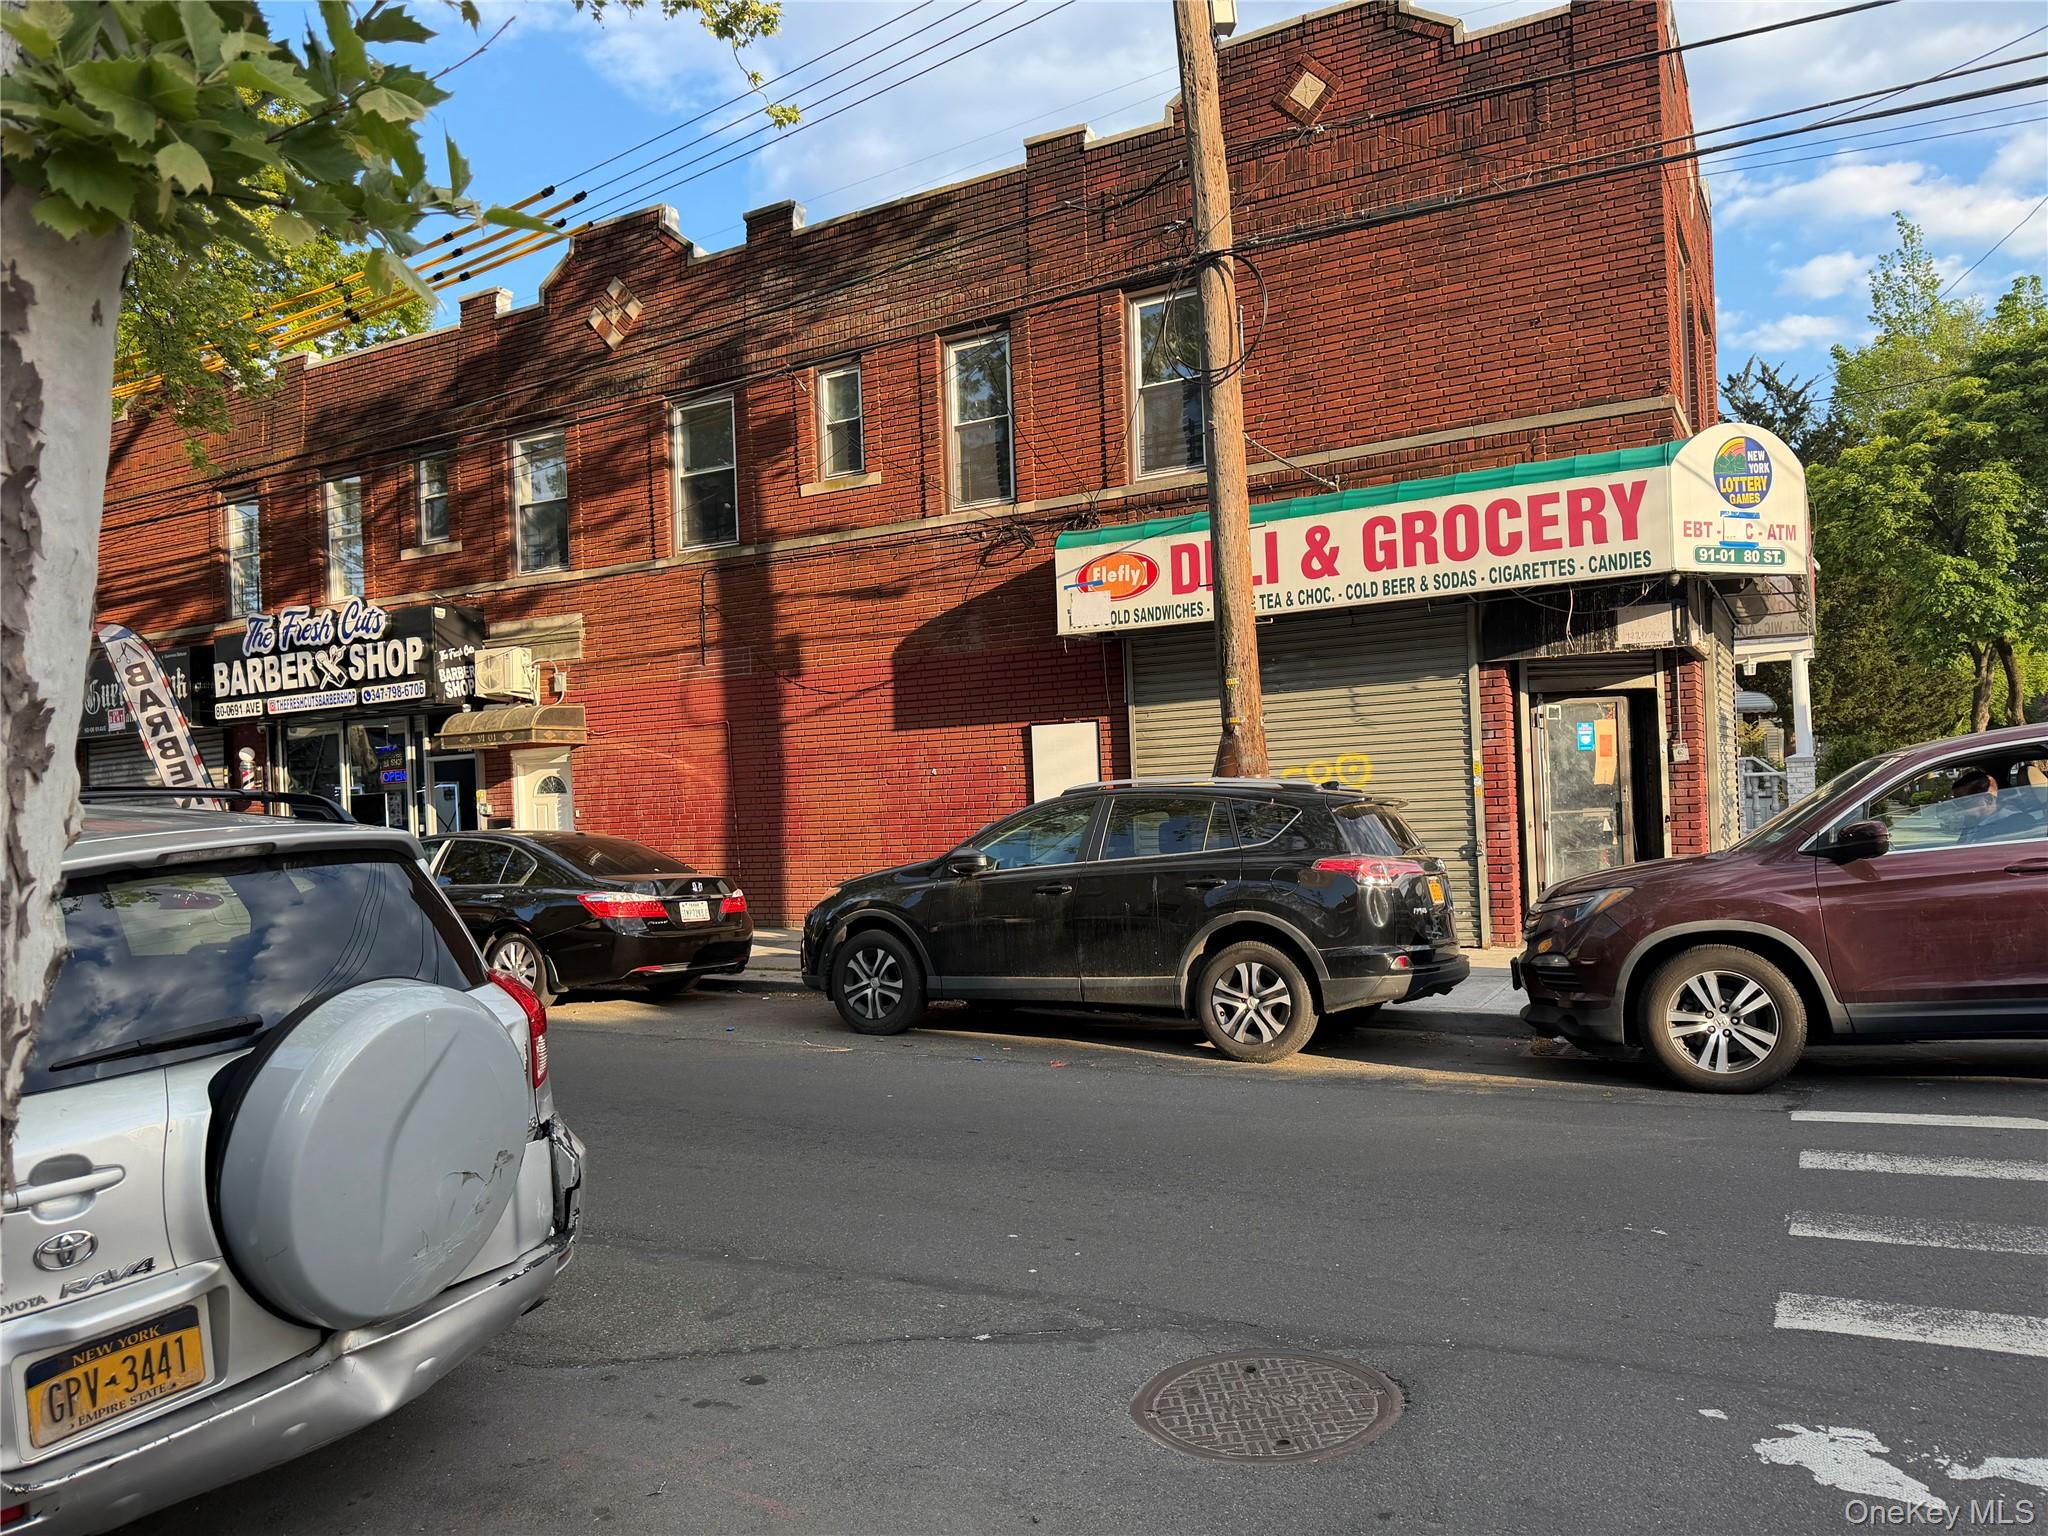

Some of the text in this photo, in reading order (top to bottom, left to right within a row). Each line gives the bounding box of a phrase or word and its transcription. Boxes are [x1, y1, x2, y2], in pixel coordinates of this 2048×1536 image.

[1747, 450, 1765, 461] NEW
[1748, 462, 1770, 474] YORK
[1719, 475, 1768, 493] LOTTERY
[1729, 492, 1761, 505] GAMES
[1301, 525, 1340, 580] &
[1362, 480, 1647, 573] GROCERY
[1683, 520, 1713, 538] EBT
[1767, 524, 1797, 541] ATM
[1699, 549, 1782, 564] 91-01 80 ST.
[1259, 592, 1282, 610] TEA
[1286, 591, 1295, 607] &
[1297, 587, 1335, 606] CHOC.
[1346, 581, 1378, 600] COLD
[1383, 577, 1416, 595] BEER
[1420, 575, 1429, 592] &
[1433, 569, 1477, 590] SODAS
[1489, 558, 1576, 584] CIGARETTES
[1588, 550, 1652, 573] CANDIES
[1105, 607, 1130, 626] OLD
[1134, 601, 1204, 624] SANDWICHES
[244, 597, 385, 654] The Fresh Cuts
[213, 651, 318, 698] BARBER
[349, 637, 424, 681] SHOP
[438, 665, 475, 683] BARBER
[371, 683, 425, 701] 347-798-6706
[445, 679, 475, 698] SHOP
[245, 702, 261, 714] AVE
[383, 770, 407, 782] OPEN
[59, 1256, 156, 1299] RAV4
[72, 1324, 161, 1368] NEW YORK
[121, 1335, 187, 1393] 3441
[78, 1382, 167, 1426] EMPIRE STATE
